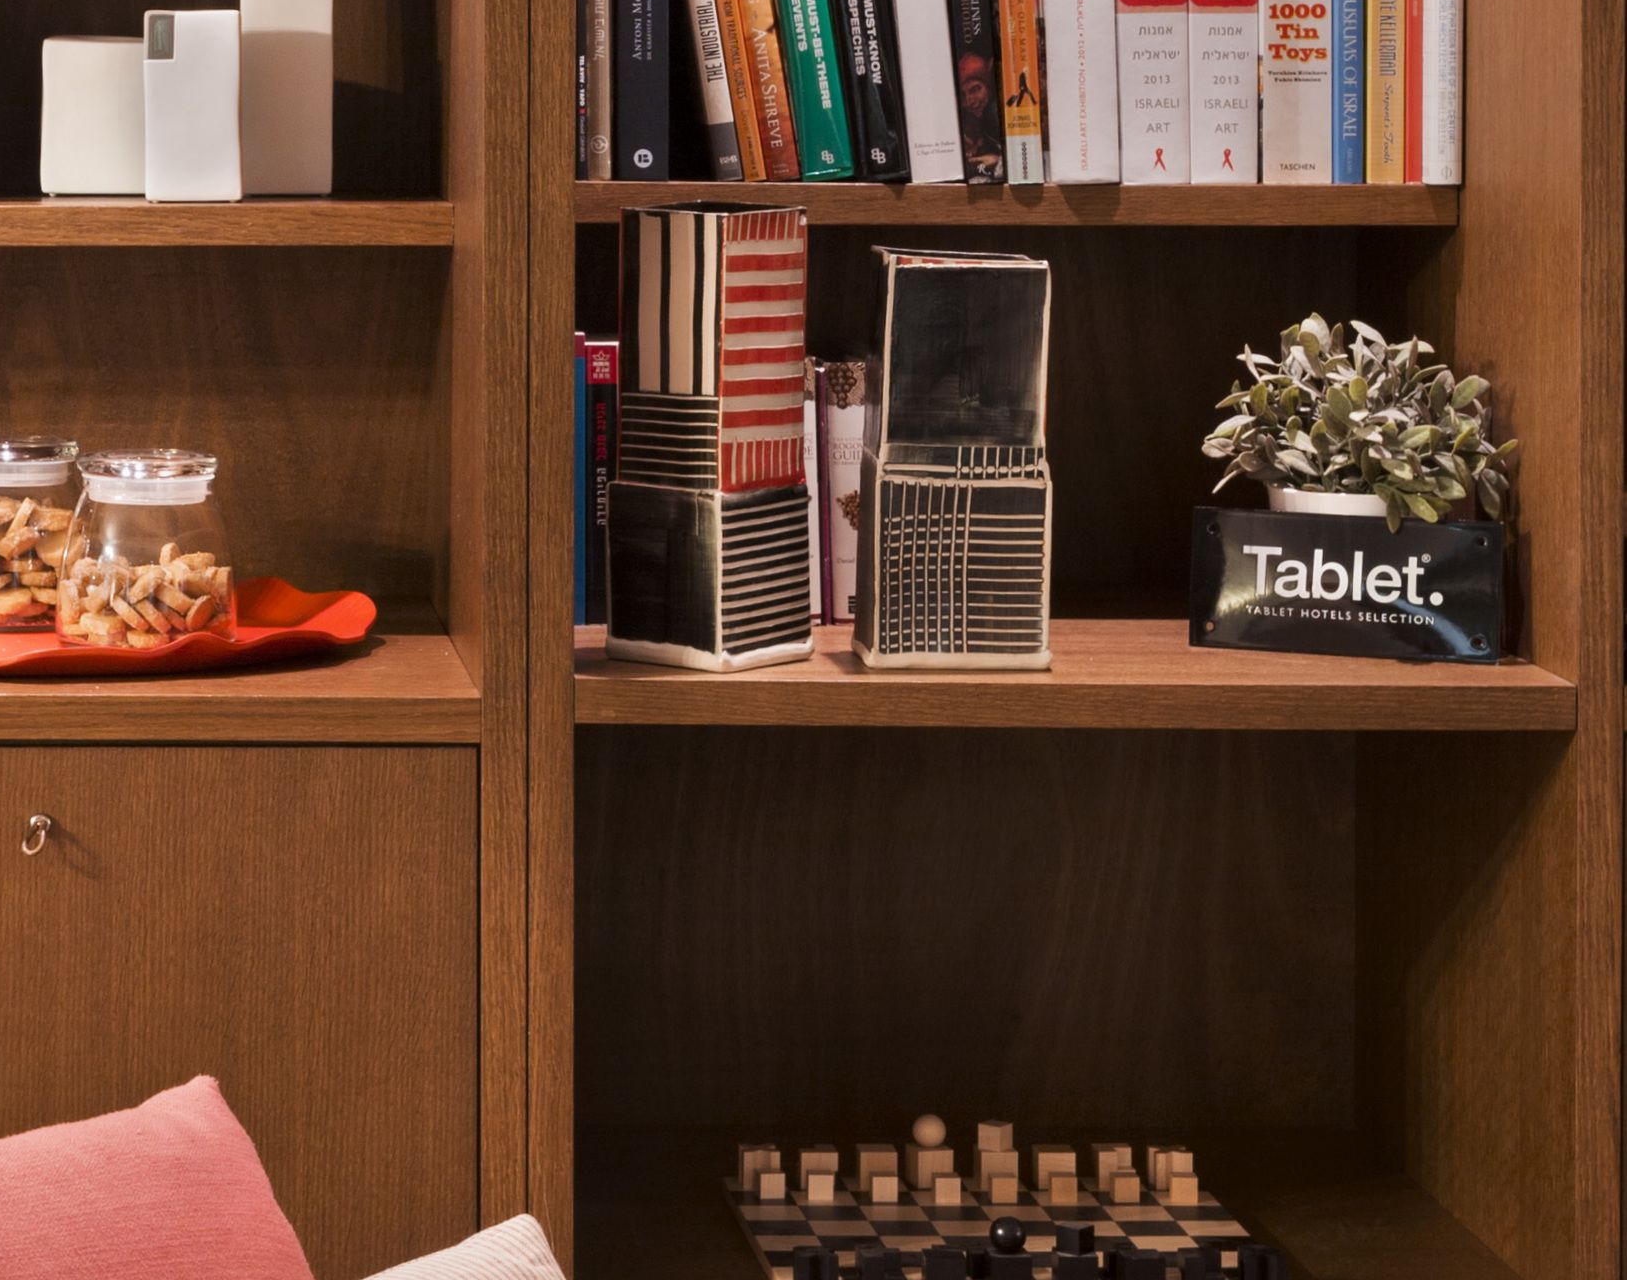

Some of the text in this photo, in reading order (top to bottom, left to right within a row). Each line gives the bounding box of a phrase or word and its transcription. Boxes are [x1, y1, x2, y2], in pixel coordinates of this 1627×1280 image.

[1268, 3, 1327, 20] 1000
[593, 17, 606, 62] בישראל
[631, 17, 643, 61] ANTONI
[696, 0, 722, 61] INDUSTRIAL
[1137, 25, 1174, 37] אמנות
[1207, 26, 1243, 37] אמנות
[1275, 23, 1320, 40] Tin
[726, 20, 742, 66] TRADITIONAL
[1018, 37, 1027, 62] MAN
[1267, 43, 1328, 63] Toys
[1378, 15, 1398, 77] KELLERMAN
[751, 27, 772, 82] ANITA
[1132, 49, 1181, 61] ישראלית
[1201, 49, 1250, 62] ישראלית
[705, 62, 725, 83] THE
[733, 66, 747, 100] SOURCES
[1143, 75, 1171, 85] 2013
[1213, 75, 1240, 85] 2013
[1342, 66, 1358, 87] OF
[1077, 40, 1089, 172] ISRAELI ART EXHIBITION 2012
[1134, 99, 1180, 109] ISRAELI
[1203, 99, 1249, 110] ISRAELI
[761, 84, 783, 149] SHREVE
[1342, 93, 1358, 141] ISRAEL
[1382, 82, 1394, 164] Serpent's Tooth
[1146, 122, 1172, 134] ART
[1214, 122, 1239, 135] ART
[1279, 163, 1316, 171] TASCHEN
[596, 467, 606, 526] הפירמידה
[1242, 544, 1444, 607] Tablet.
[1245, 604, 1435, 626] TABLET HOTELS SELECTION
